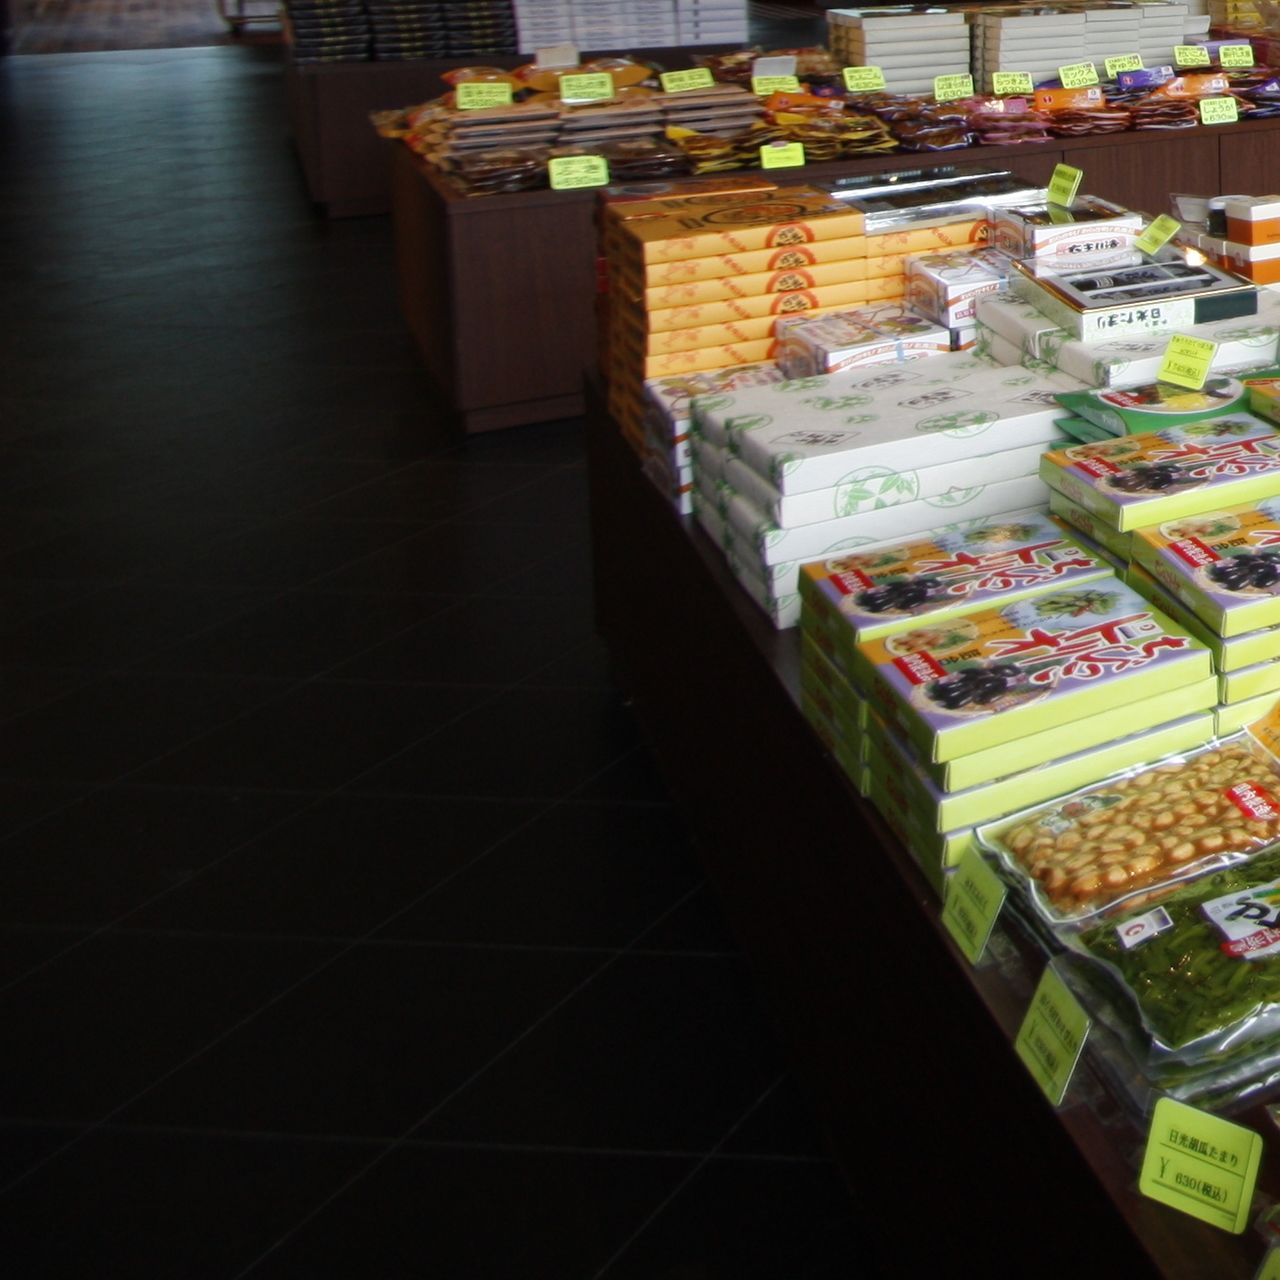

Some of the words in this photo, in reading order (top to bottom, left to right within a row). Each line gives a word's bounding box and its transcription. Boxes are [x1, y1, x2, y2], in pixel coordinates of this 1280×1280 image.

[1168, 1128, 1239, 1168] 日光胡瓜たまり
